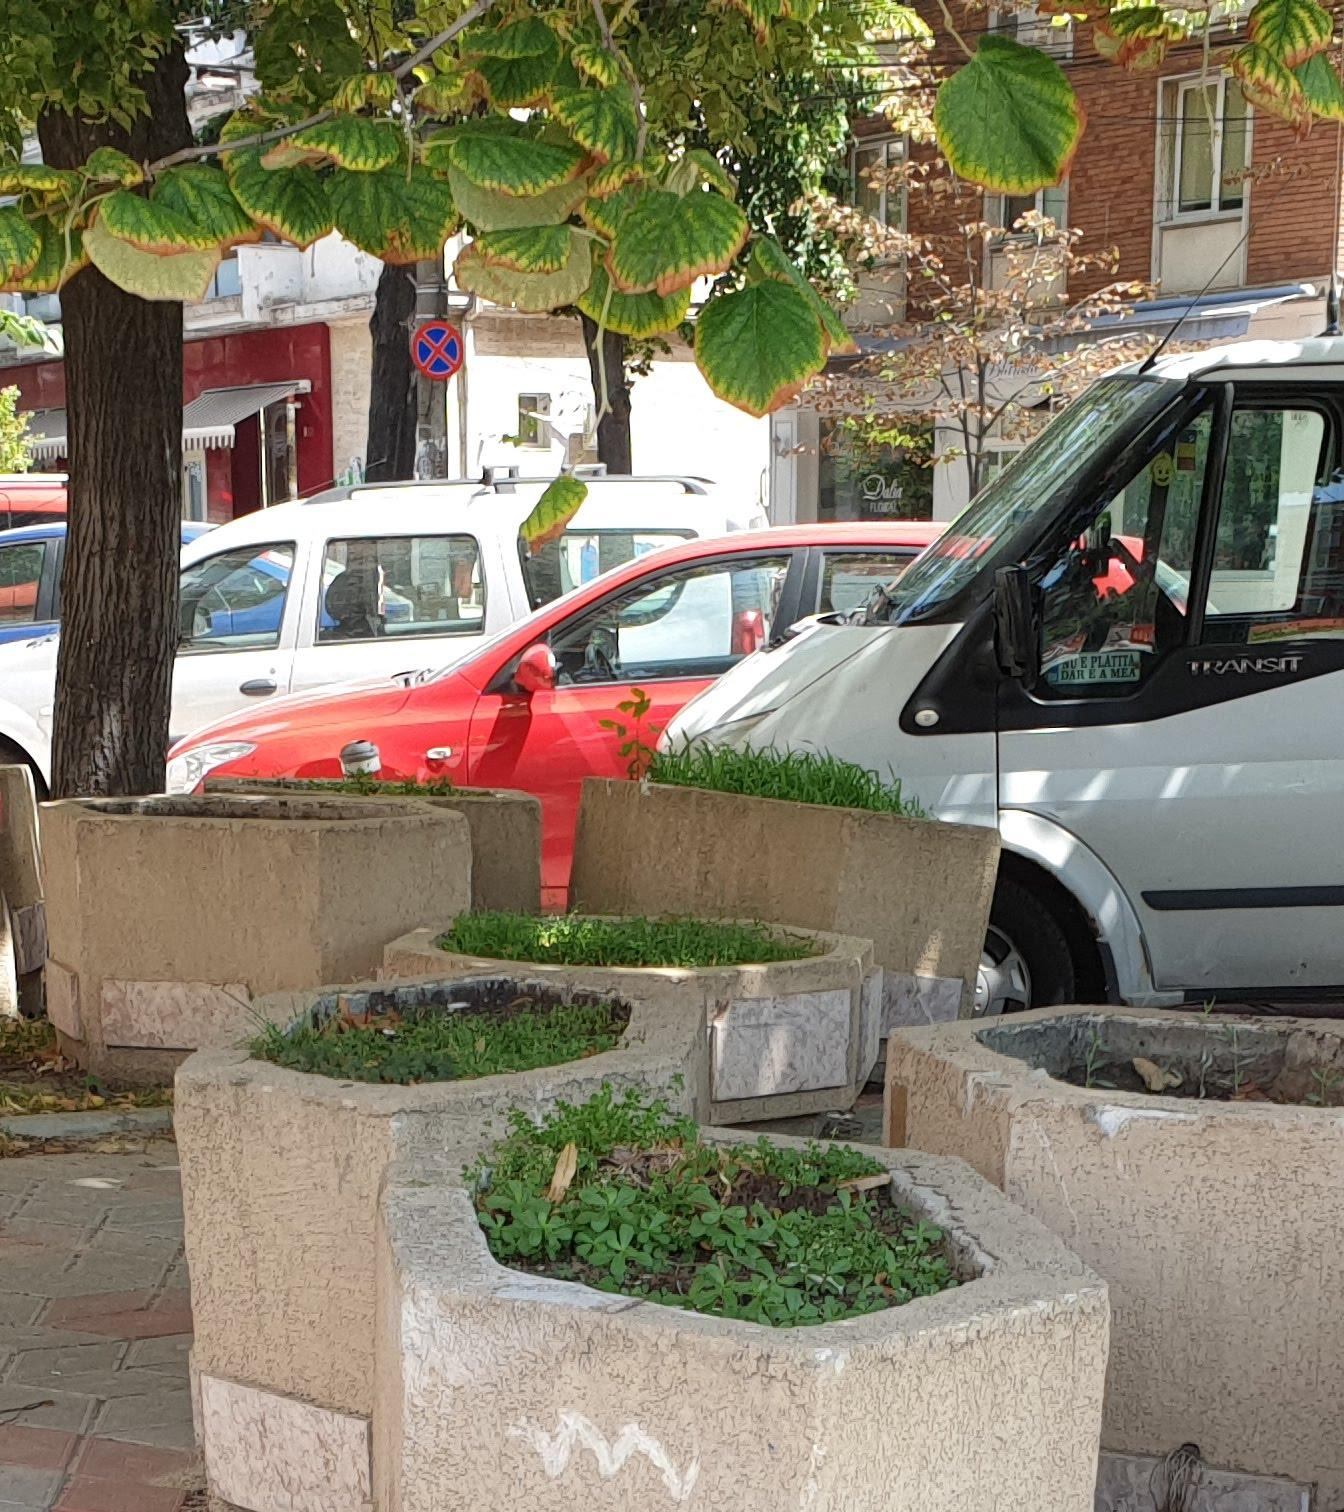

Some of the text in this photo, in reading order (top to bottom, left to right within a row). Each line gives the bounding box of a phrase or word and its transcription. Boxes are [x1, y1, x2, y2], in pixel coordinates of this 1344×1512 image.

[1061, 667, 1136, 680] DAR E A MEA
[1186, 656, 1303, 676] TRANSIT
